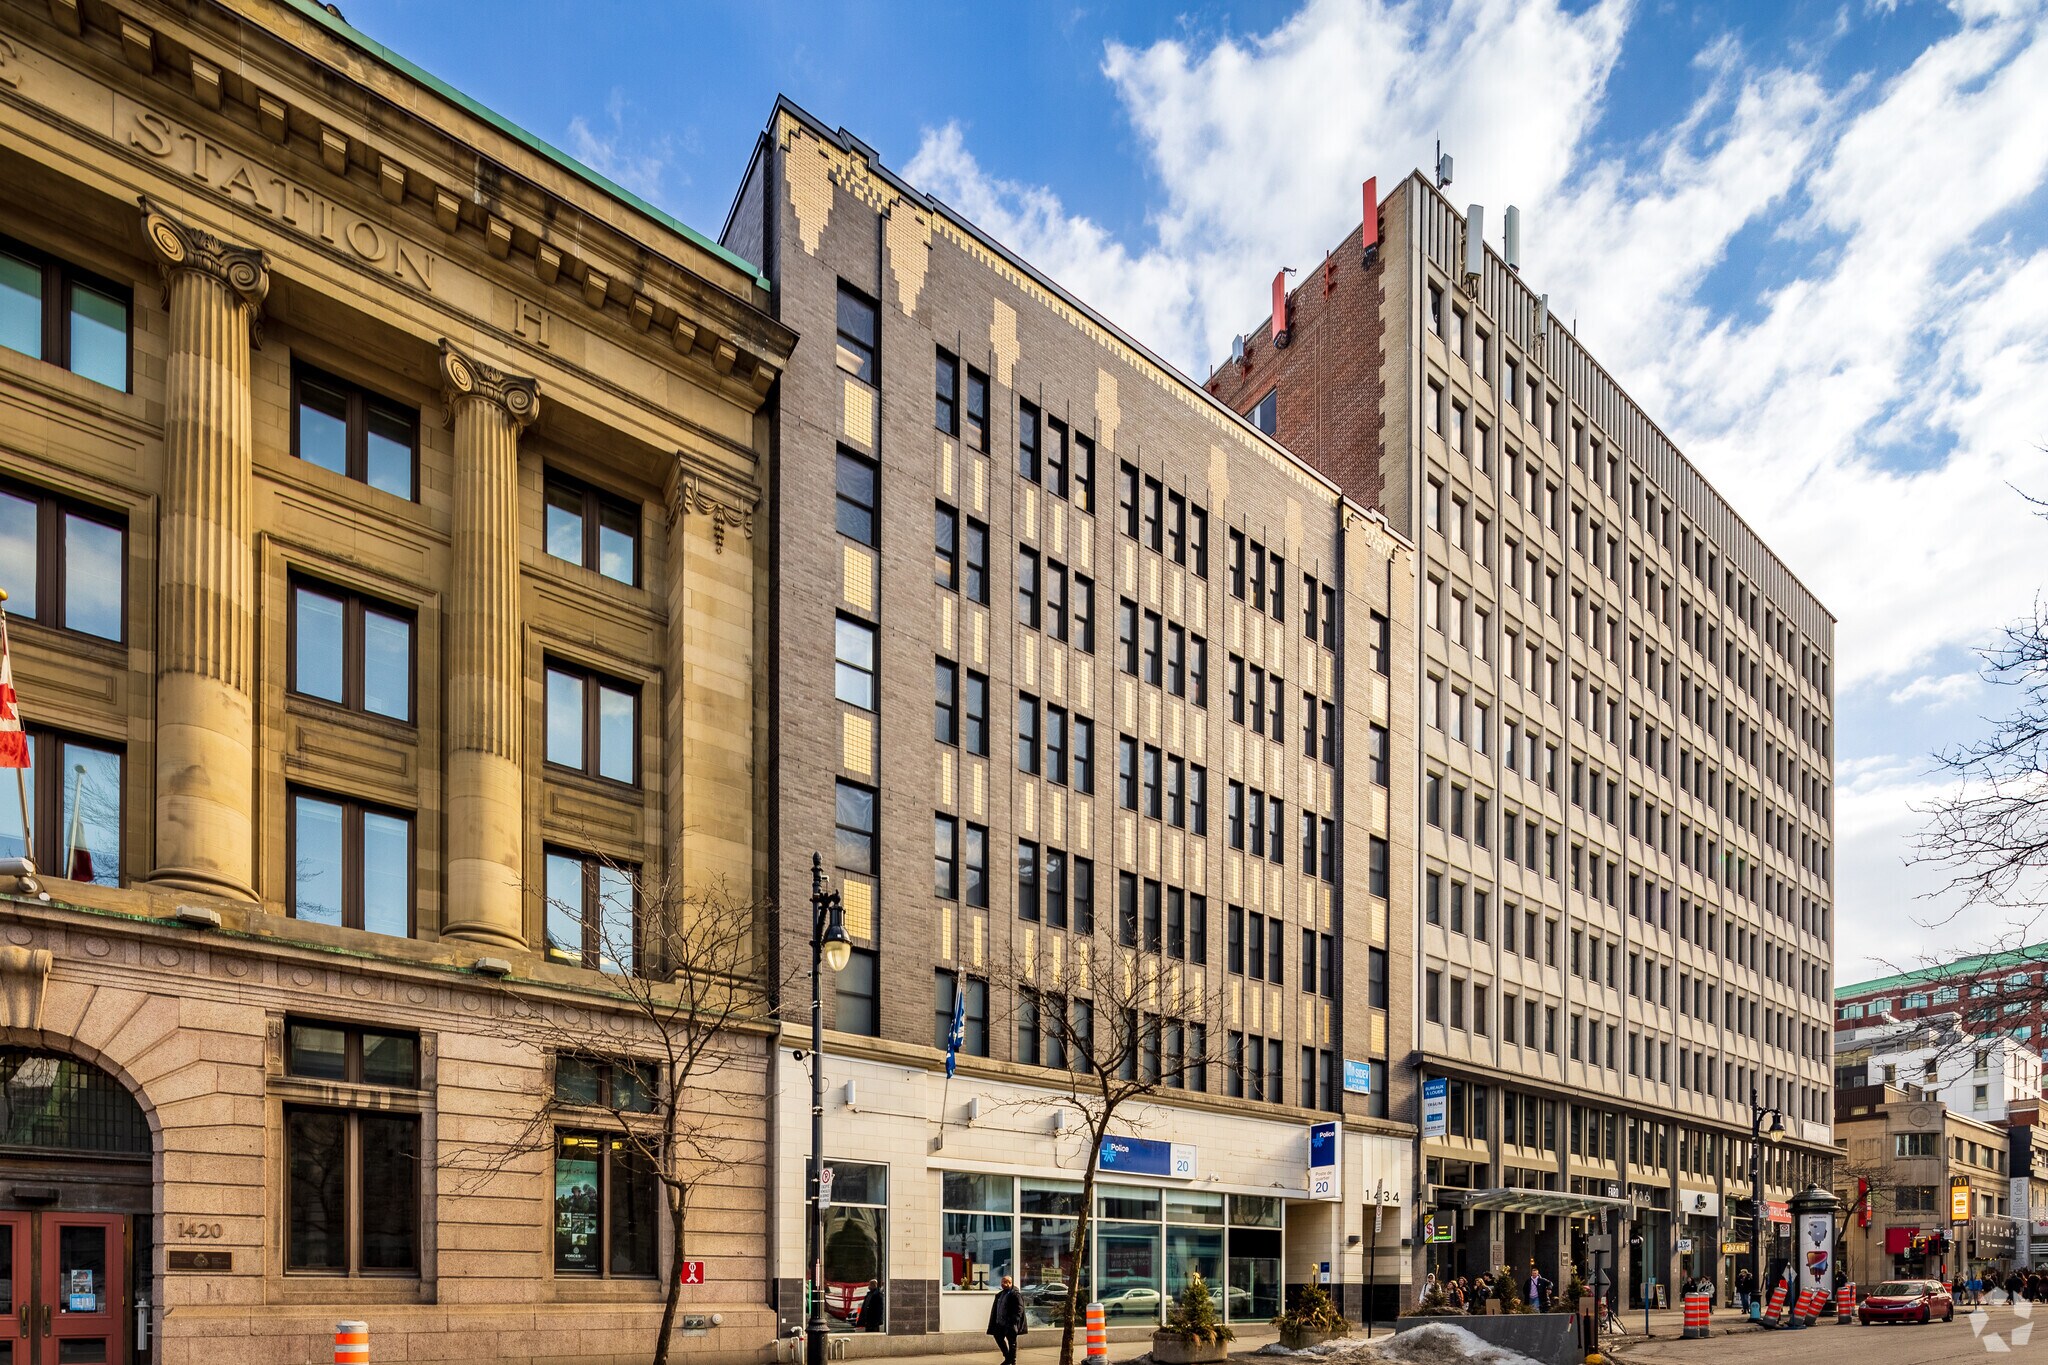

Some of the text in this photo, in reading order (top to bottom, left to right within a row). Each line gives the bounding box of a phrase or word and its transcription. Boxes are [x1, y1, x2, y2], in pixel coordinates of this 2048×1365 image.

[130, 112, 550, 349] STATION H
[1110, 1143, 1129, 1153] Police
[1177, 1160, 1189, 1172] 20
[1315, 1181, 1329, 1193] 20
[177, 1222, 224, 1239] 1420
